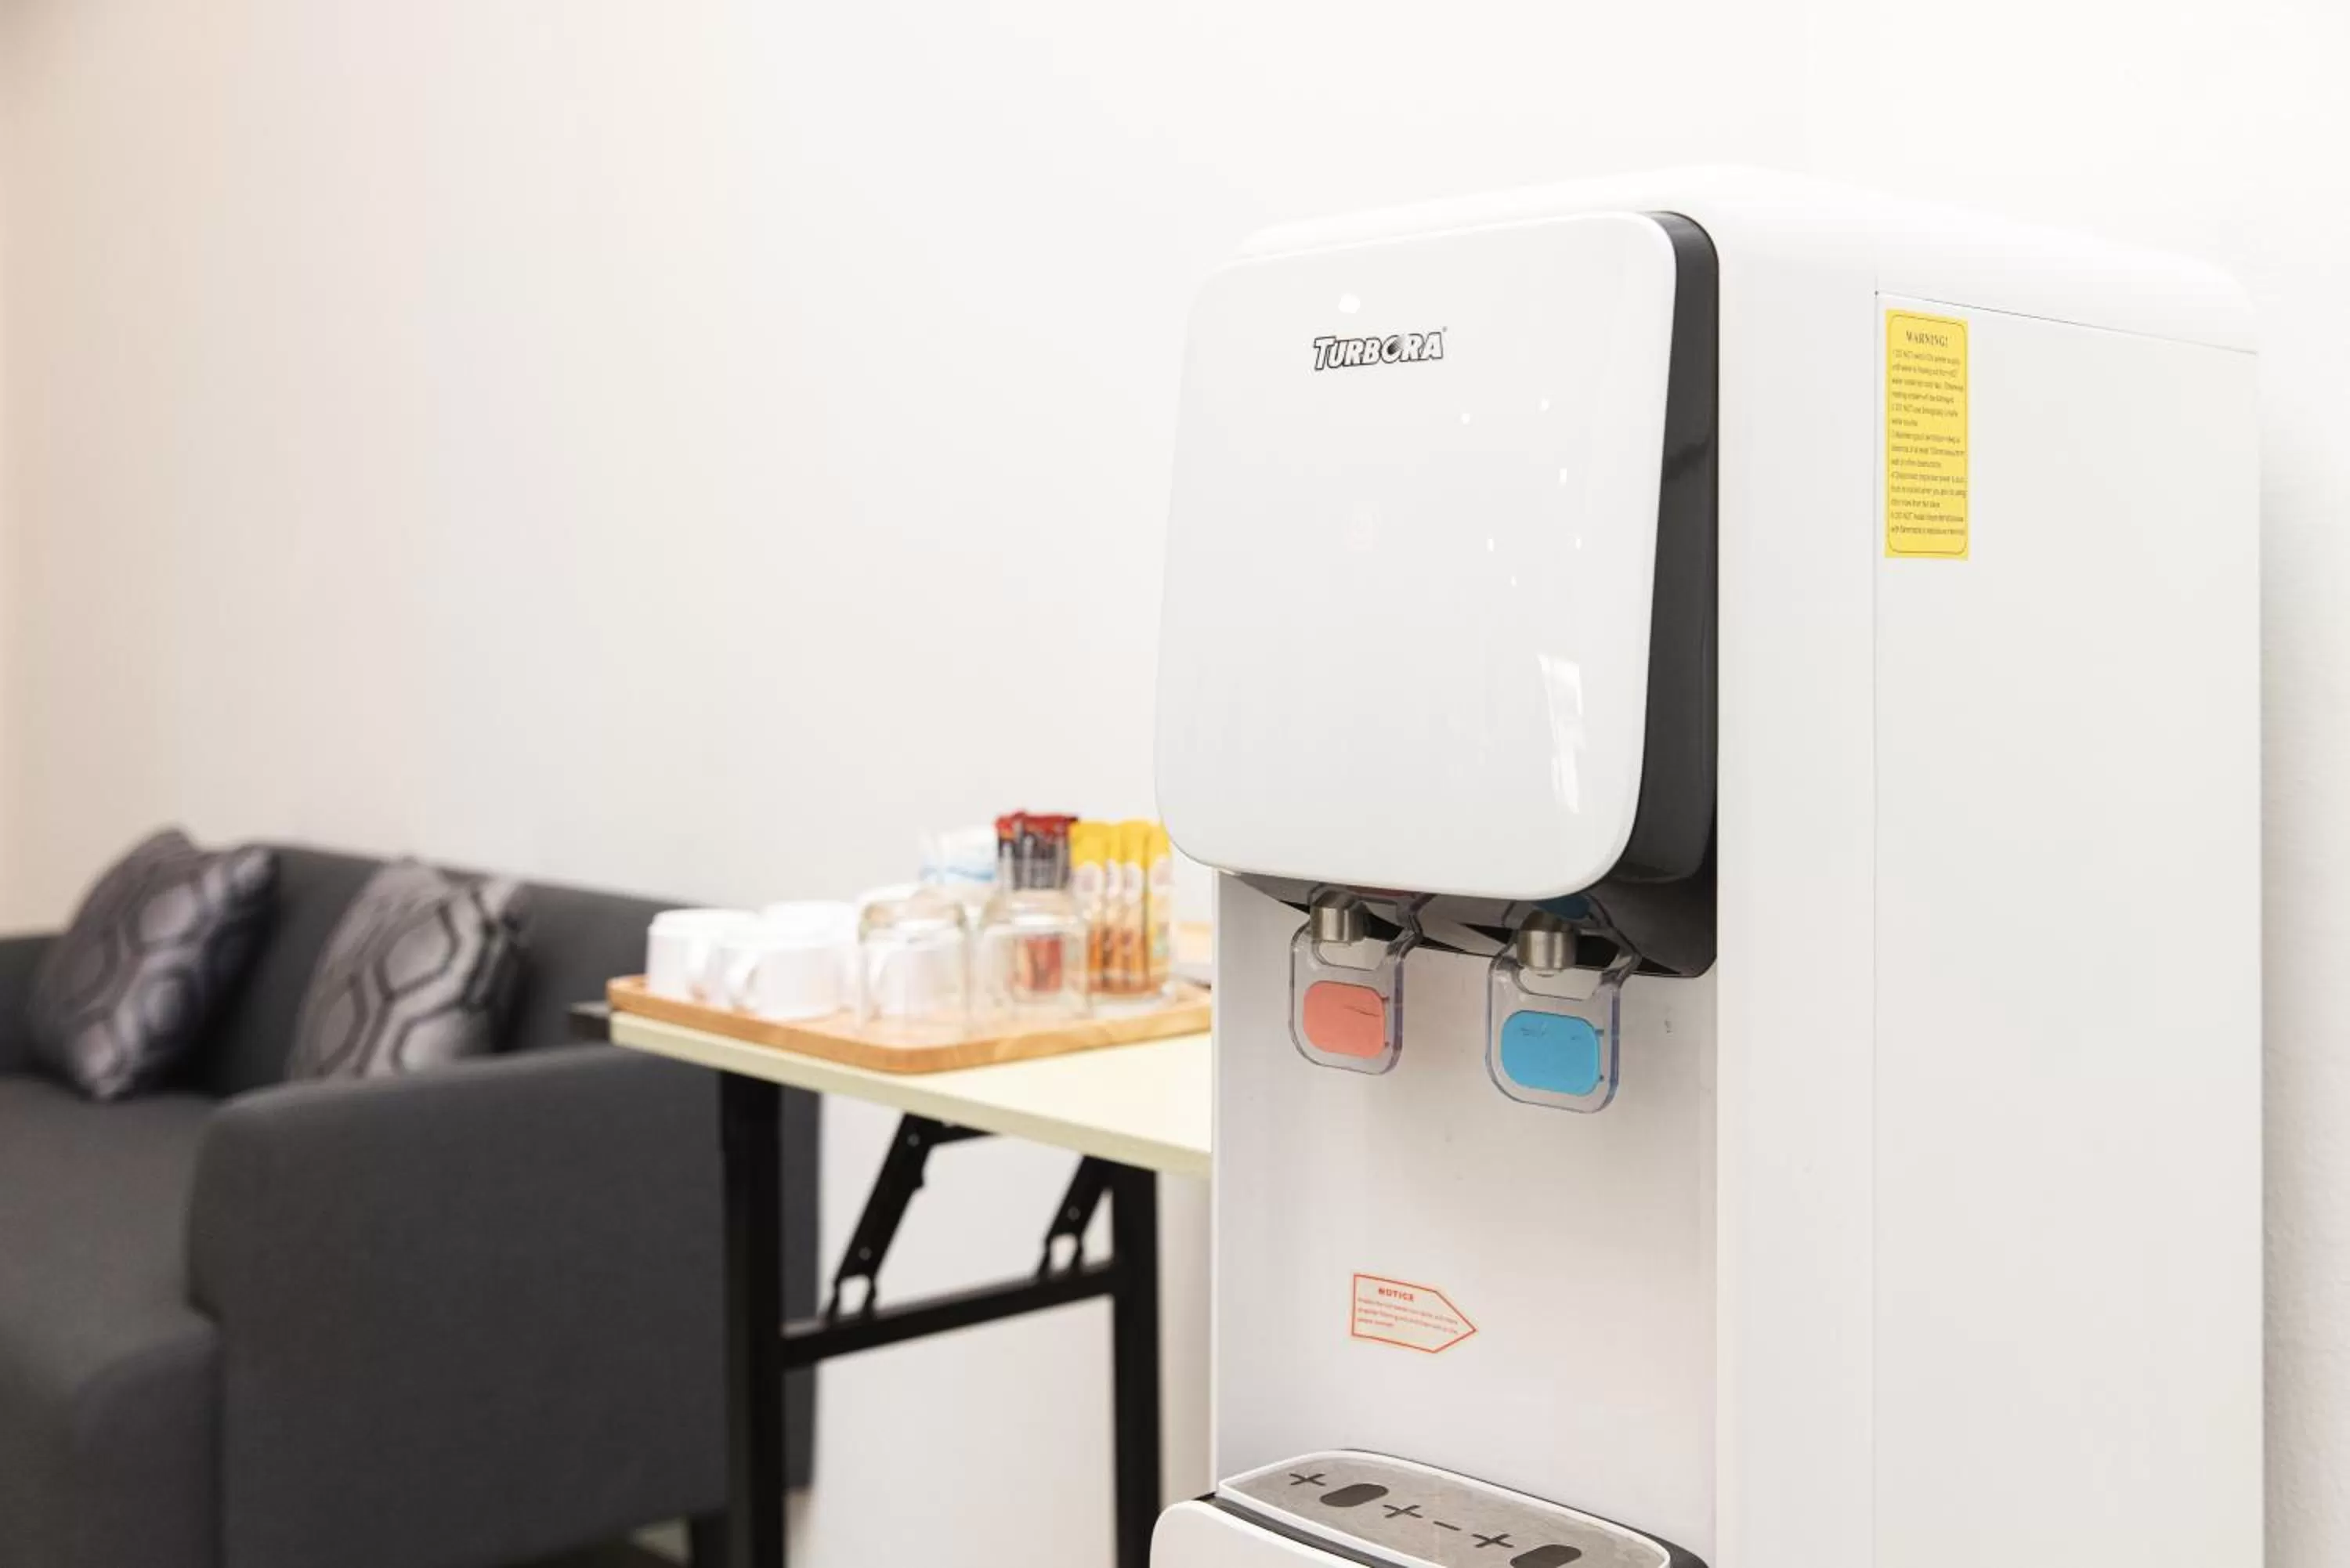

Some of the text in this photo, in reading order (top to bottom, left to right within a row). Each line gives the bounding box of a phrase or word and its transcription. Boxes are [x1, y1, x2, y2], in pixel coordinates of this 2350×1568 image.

[1906, 330, 1949, 348] WARNING!
[1313, 331, 1444, 371] TURBORA
[1378, 1287, 1415, 1302] NOTICE
